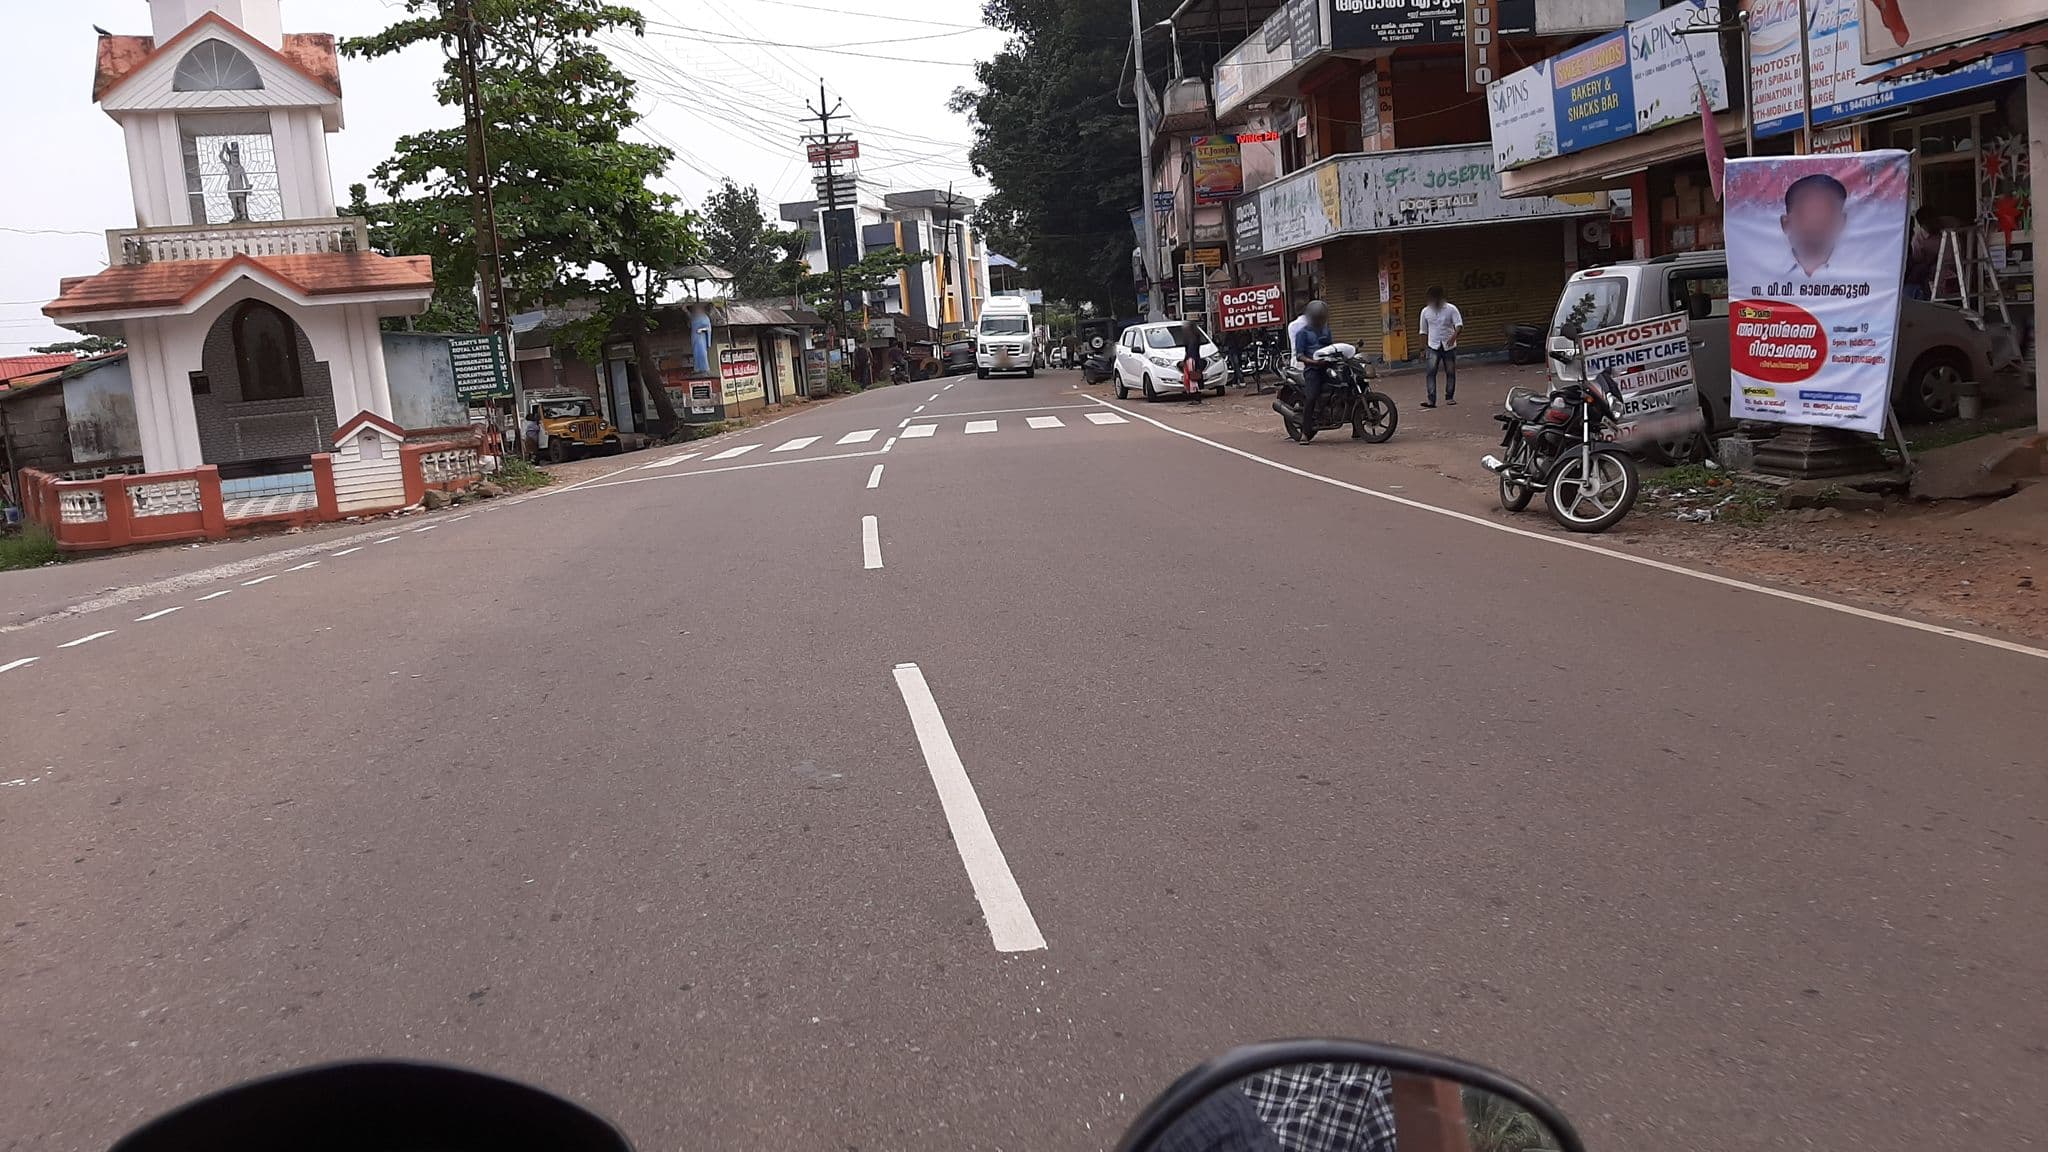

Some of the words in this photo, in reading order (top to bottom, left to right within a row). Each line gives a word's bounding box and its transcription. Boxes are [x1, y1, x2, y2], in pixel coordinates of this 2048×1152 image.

[1631, 18, 1682, 62] SAPINS
[1751, 53, 1802, 76] PHOTOSTA
[1836, 68, 1856, 82] CAFE
[1571, 79, 1602, 102] BAKERY
[1604, 76, 1611, 91] &
[1768, 72, 1792, 86] SPIRAL
[1492, 79, 1529, 113] SAPINS
[1568, 97, 1600, 122] SNACKS
[1601, 92, 1619, 112] BAR
[1224, 311, 1281, 328] HOTEL
[1583, 318, 1682, 351] PHOTOSTAT
[1587, 348, 1652, 370] INTERNET
[1654, 341, 1688, 359] CAFE
[1749, 340, 1817, 359] ദിനാചരണം
[1637, 365, 1689, 387] BINDING
